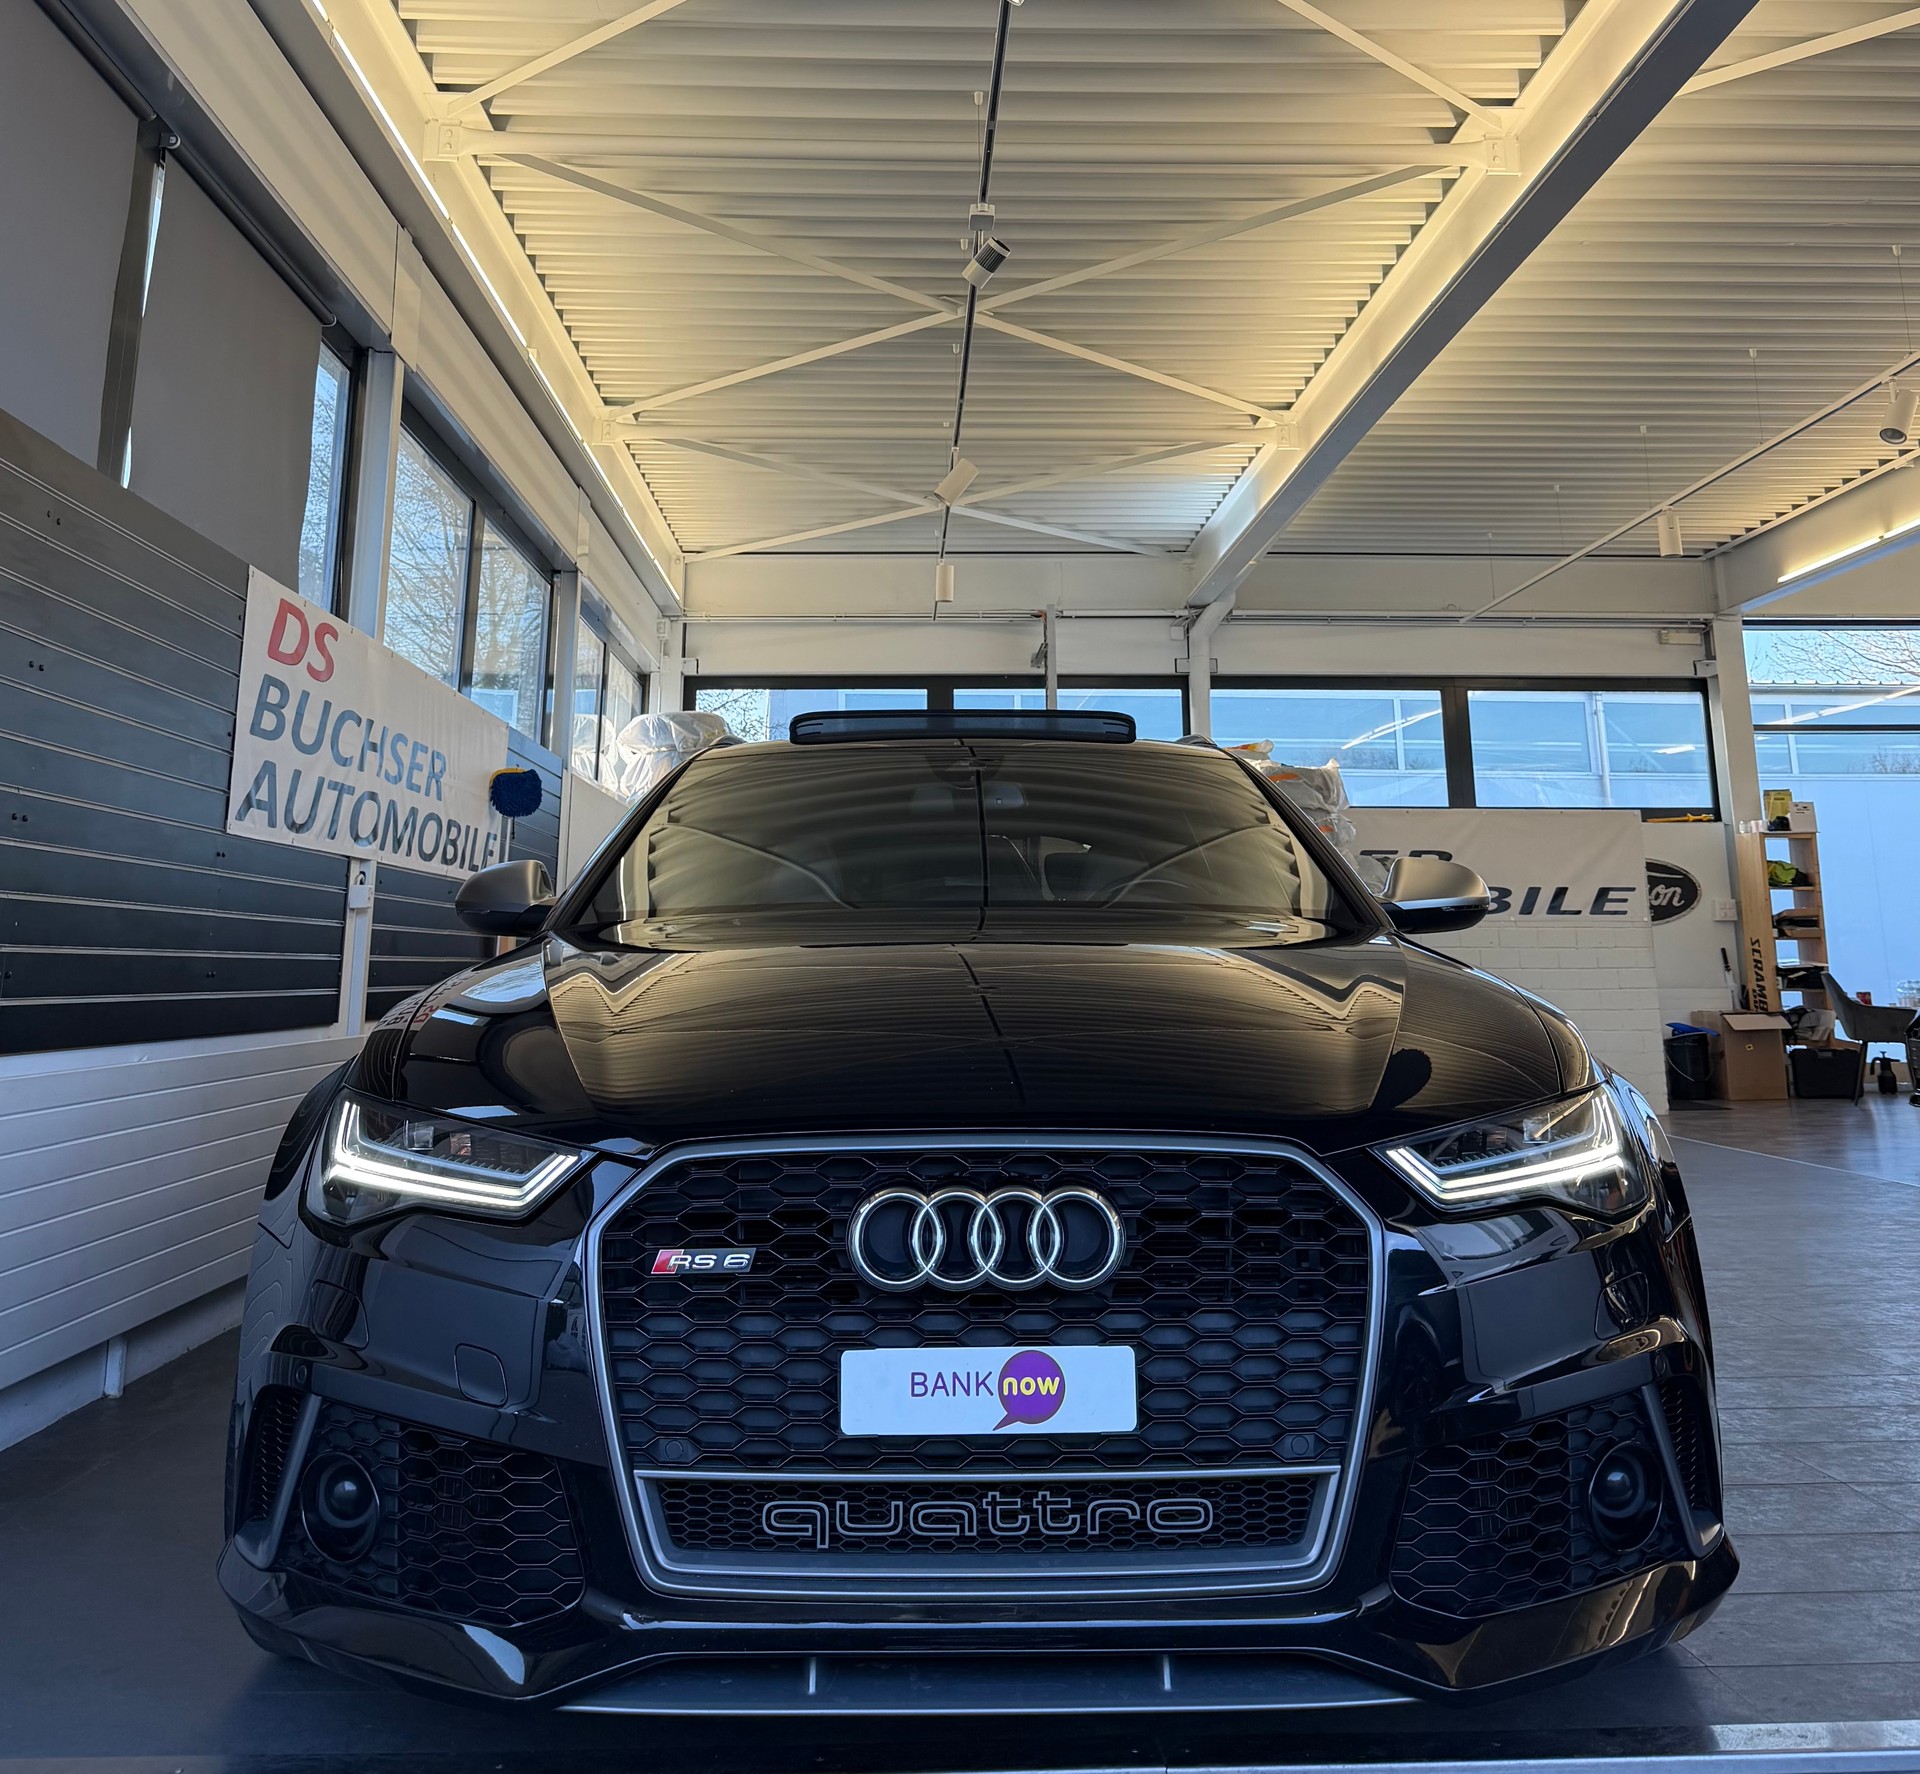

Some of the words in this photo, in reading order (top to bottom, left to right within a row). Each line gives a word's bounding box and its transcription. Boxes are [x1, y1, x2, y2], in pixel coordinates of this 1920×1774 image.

[267, 597, 339, 682] DS
[250, 673, 447, 801] BUCHSER
[235, 760, 498, 873] AUTOMOBILE
[667, 1254, 717, 1271] RS
[723, 1253, 751, 1269] 6
[910, 1371, 994, 1398] BANK
[1003, 1376, 1060, 1396] now
[762, 1491, 1214, 1549] quattro
